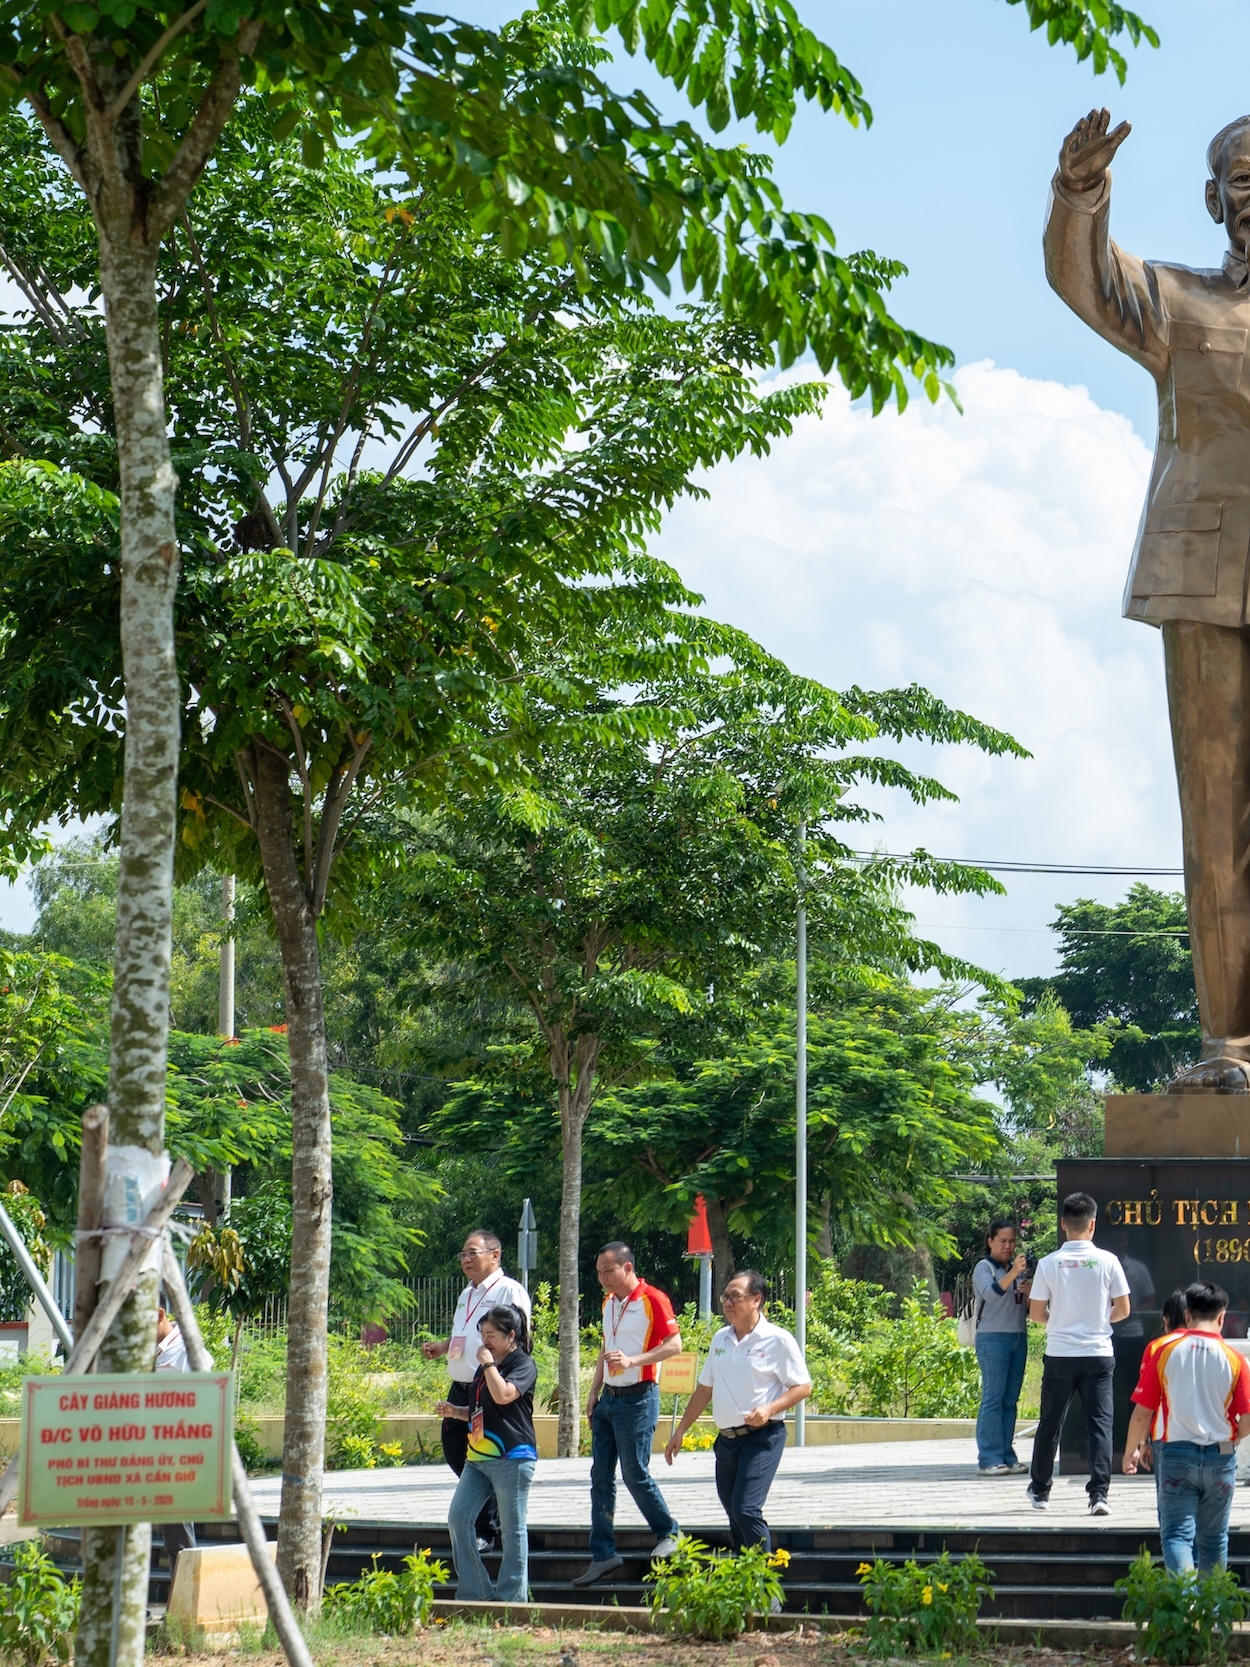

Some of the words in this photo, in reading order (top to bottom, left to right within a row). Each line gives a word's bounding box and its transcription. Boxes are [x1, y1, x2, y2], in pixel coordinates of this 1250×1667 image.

[1105, 1189, 1163, 1226] CHỦ
[1172, 1199, 1240, 1231] TỊCH
[59, 1392, 88, 1411] CÂY
[93, 1391, 140, 1410] GIÁNG
[145, 1391, 196, 1409] HƯƠNG
[40, 1427, 72, 1444] Đ/C
[79, 1424, 102, 1442] VÕ
[108, 1423, 146, 1441] HỮU
[153, 1419, 213, 1440] THẮNG
[48, 1457, 74, 1470] PHÓ
[94, 1456, 118, 1469] THƯ
[120, 1453, 154, 1468] ĐẢNG
[56, 1475, 84, 1488] TỊCH
[87, 1473, 122, 1486] UBND
